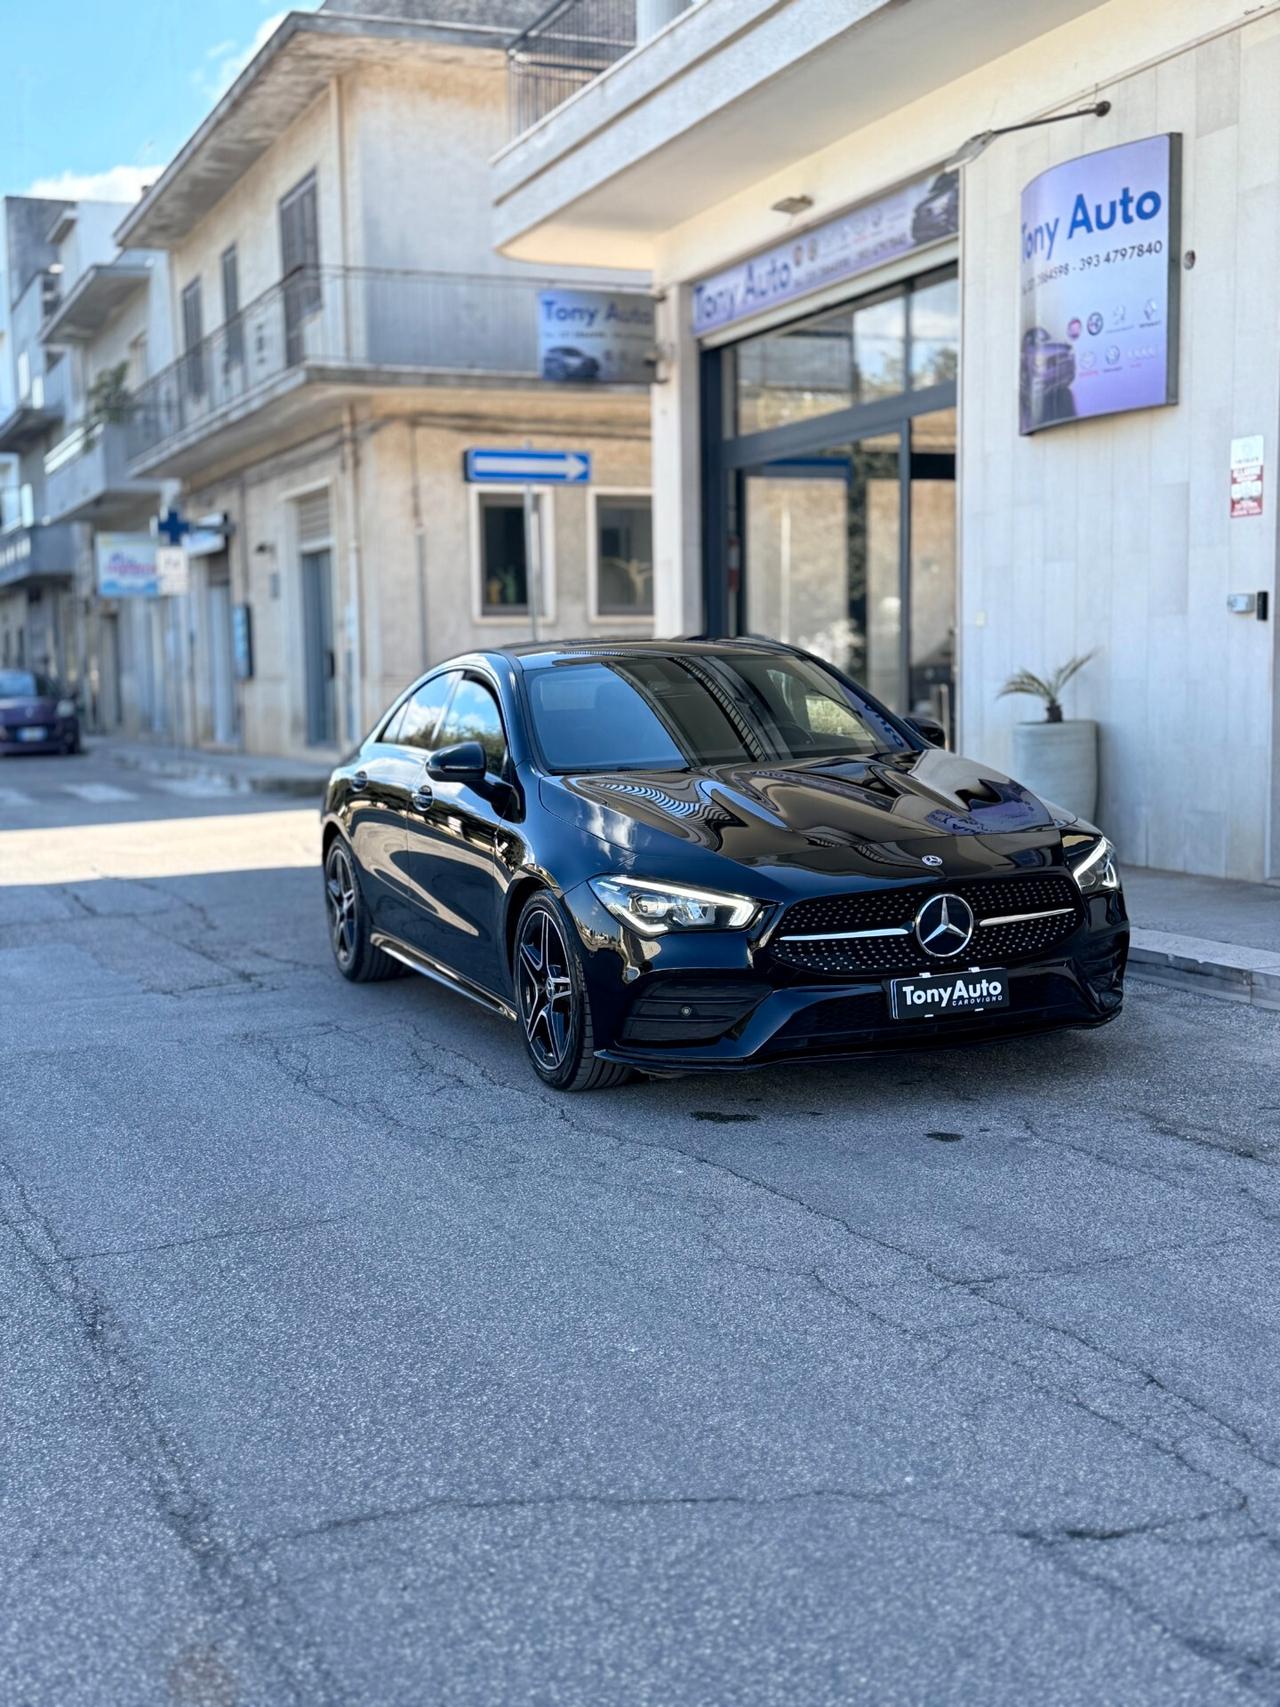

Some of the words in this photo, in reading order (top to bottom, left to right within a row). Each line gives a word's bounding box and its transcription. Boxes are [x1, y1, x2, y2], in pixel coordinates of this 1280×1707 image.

[1067, 187, 1162, 239] Auto
[1079, 254, 1101, 271] 393
[1103, 240, 1163, 263] 4797840
[695, 285, 736, 322] Tony
[742, 261, 792, 304] Auto
[543, 299, 597, 326] Tony
[902, 979, 1002, 1007] TonyAuto
[952, 995, 1003, 1006] CAROVIGNO
